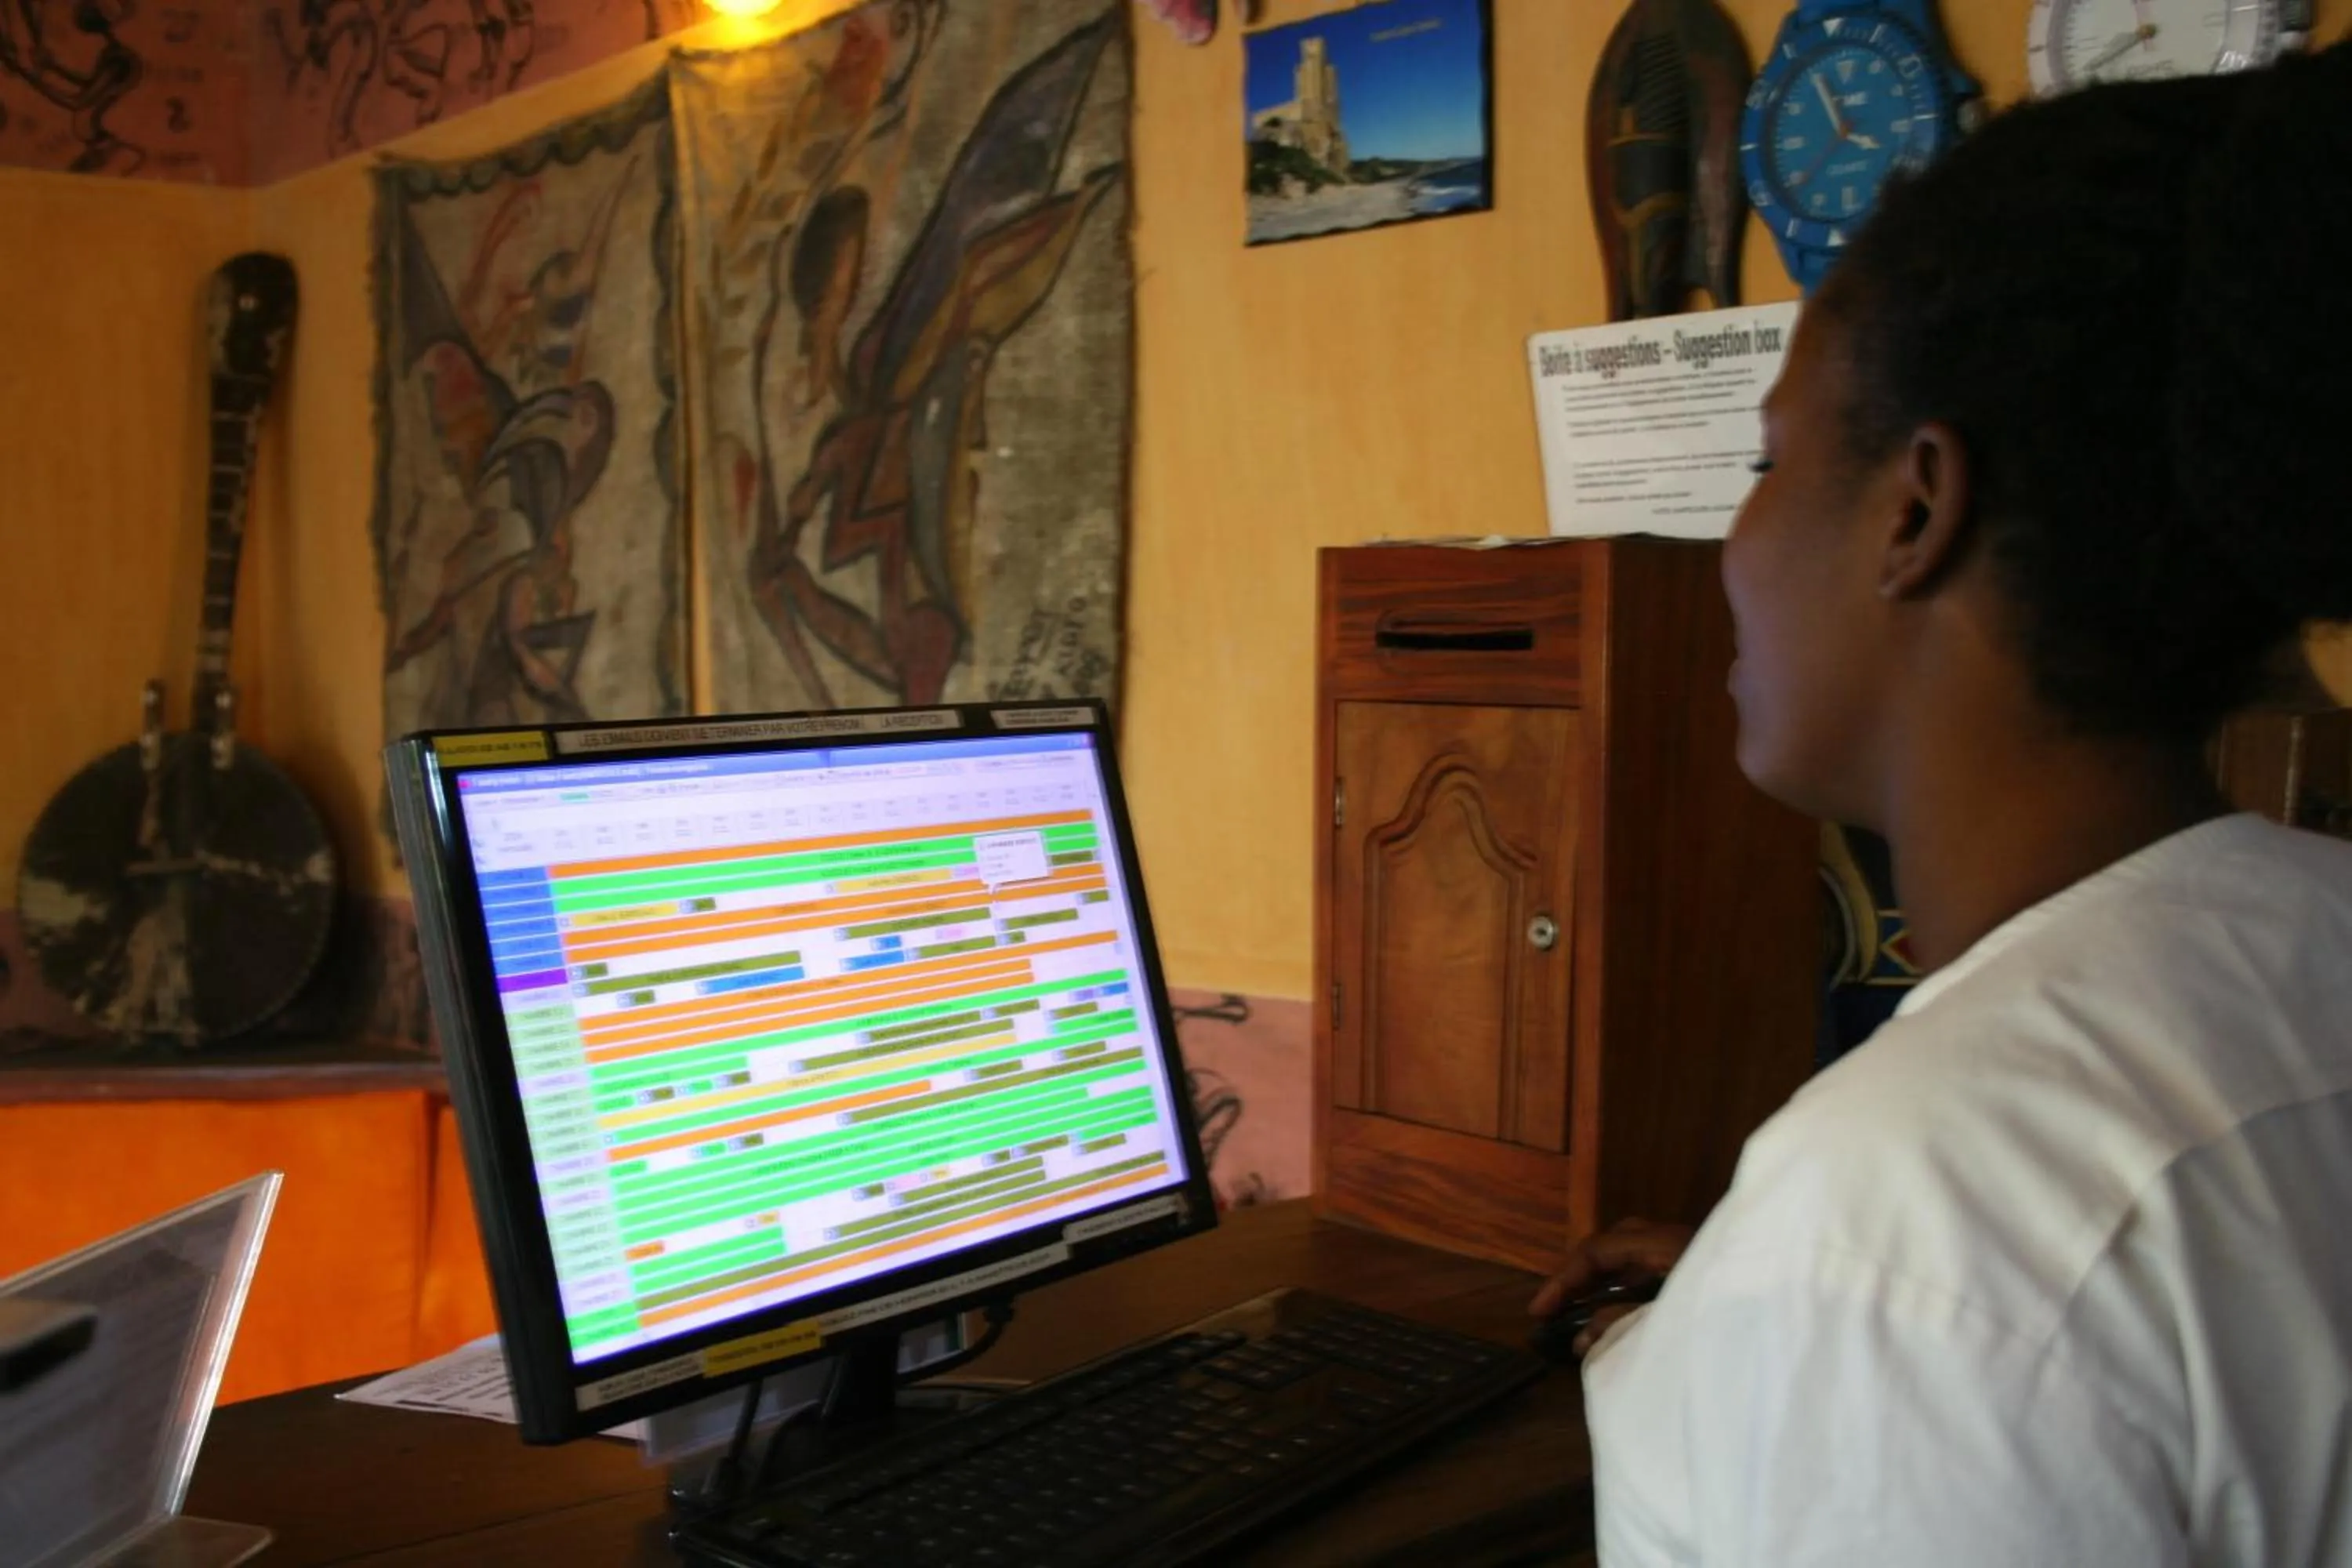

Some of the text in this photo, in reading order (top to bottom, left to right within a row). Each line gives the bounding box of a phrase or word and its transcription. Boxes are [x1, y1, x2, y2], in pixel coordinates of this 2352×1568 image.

[1584, 335, 1661, 379] suggestions
[1673, 324, 1751, 369] Suggestion
[1754, 319, 1781, 354] box
